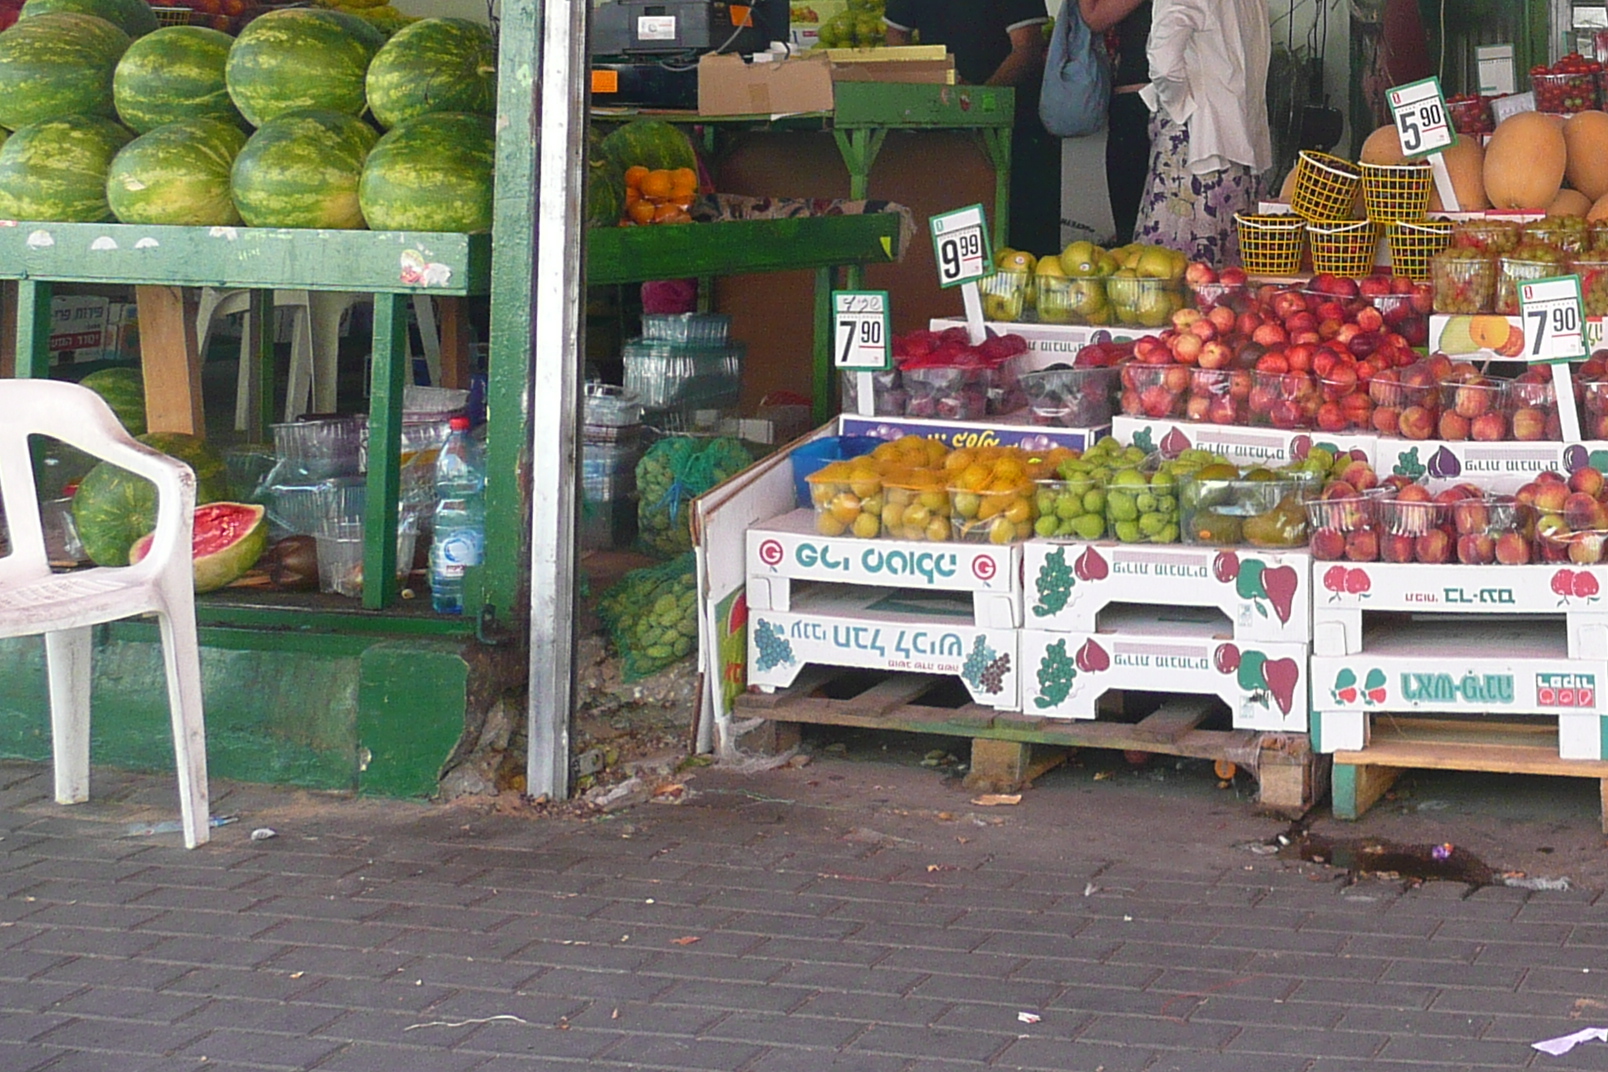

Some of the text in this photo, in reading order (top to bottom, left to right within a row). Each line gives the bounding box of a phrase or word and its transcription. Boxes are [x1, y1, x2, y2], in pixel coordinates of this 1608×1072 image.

[1465, 460, 1558, 473] פירות מובחרים
[795, 543, 957, 584] פרי מטולה
[1113, 561, 1207, 578] פירות מובחרים
[1443, 588, 1515, 605] בר-עם
[791, 620, 963, 659] ענבי חבל לכיש
[888, 659, 959, 673] מושב שדה משה
[1114, 654, 1209, 670] פירות מובחרים
